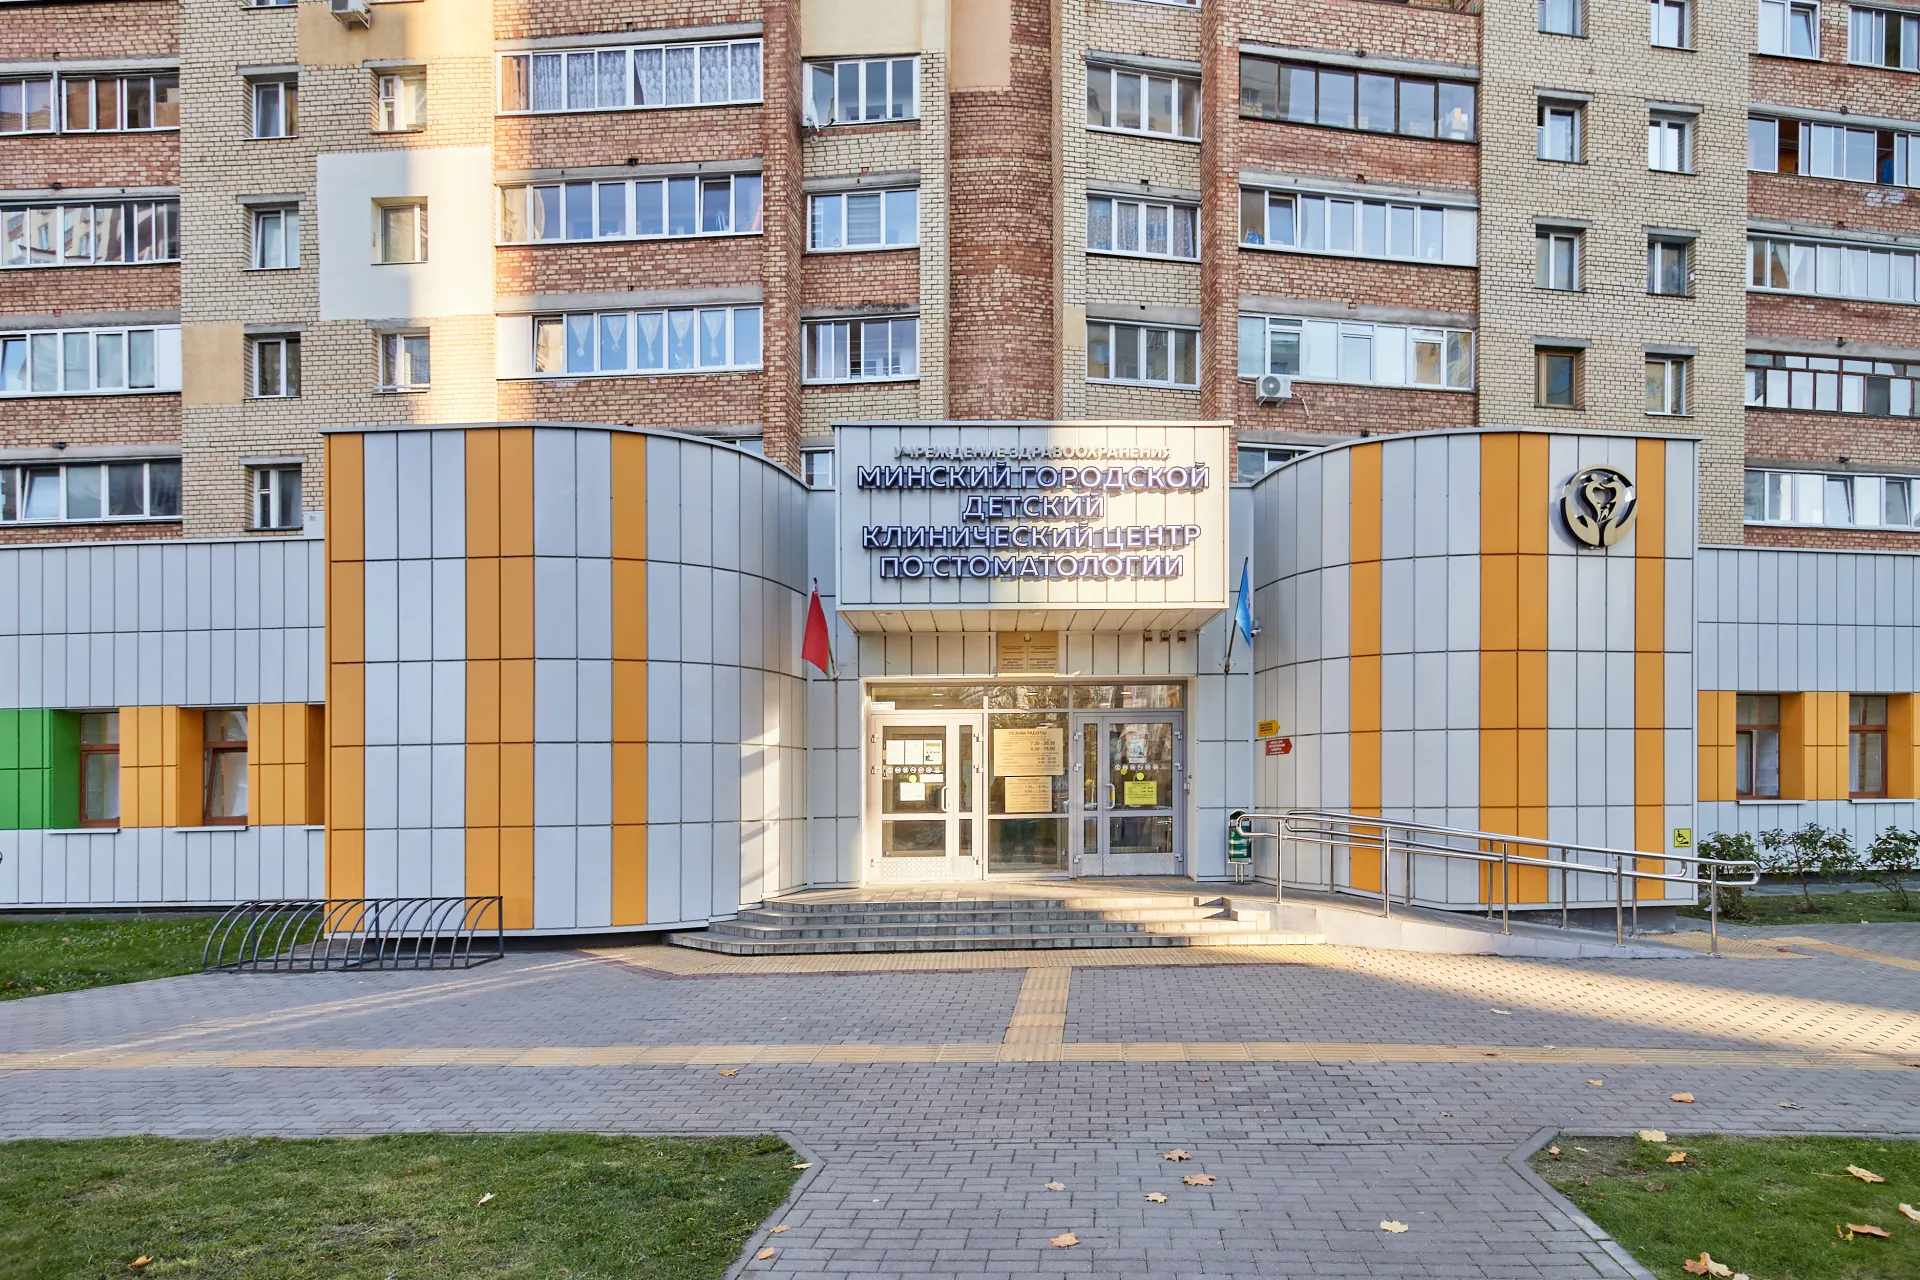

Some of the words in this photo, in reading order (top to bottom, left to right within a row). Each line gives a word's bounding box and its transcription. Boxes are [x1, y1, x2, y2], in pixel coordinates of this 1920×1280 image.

[894, 446, 1007, 460] УЧРЕЖДЕНИЕ
[1009, 445, 1171, 460] ЗДРАВООХРАНЕНИЯ
[857, 462, 1012, 489] МИНСКИЙ
[1020, 462, 1210, 491] ГОРОДСКОЙ
[962, 492, 1105, 522] ДЕТСКИЙ
[862, 521, 1094, 549] КЛИНИЧЕСКИЙ
[1102, 524, 1202, 551] ЦЕНТР
[880, 555, 925, 578] ПО
[932, 554, 1183, 578] СТОМАТОЛОГИИ
